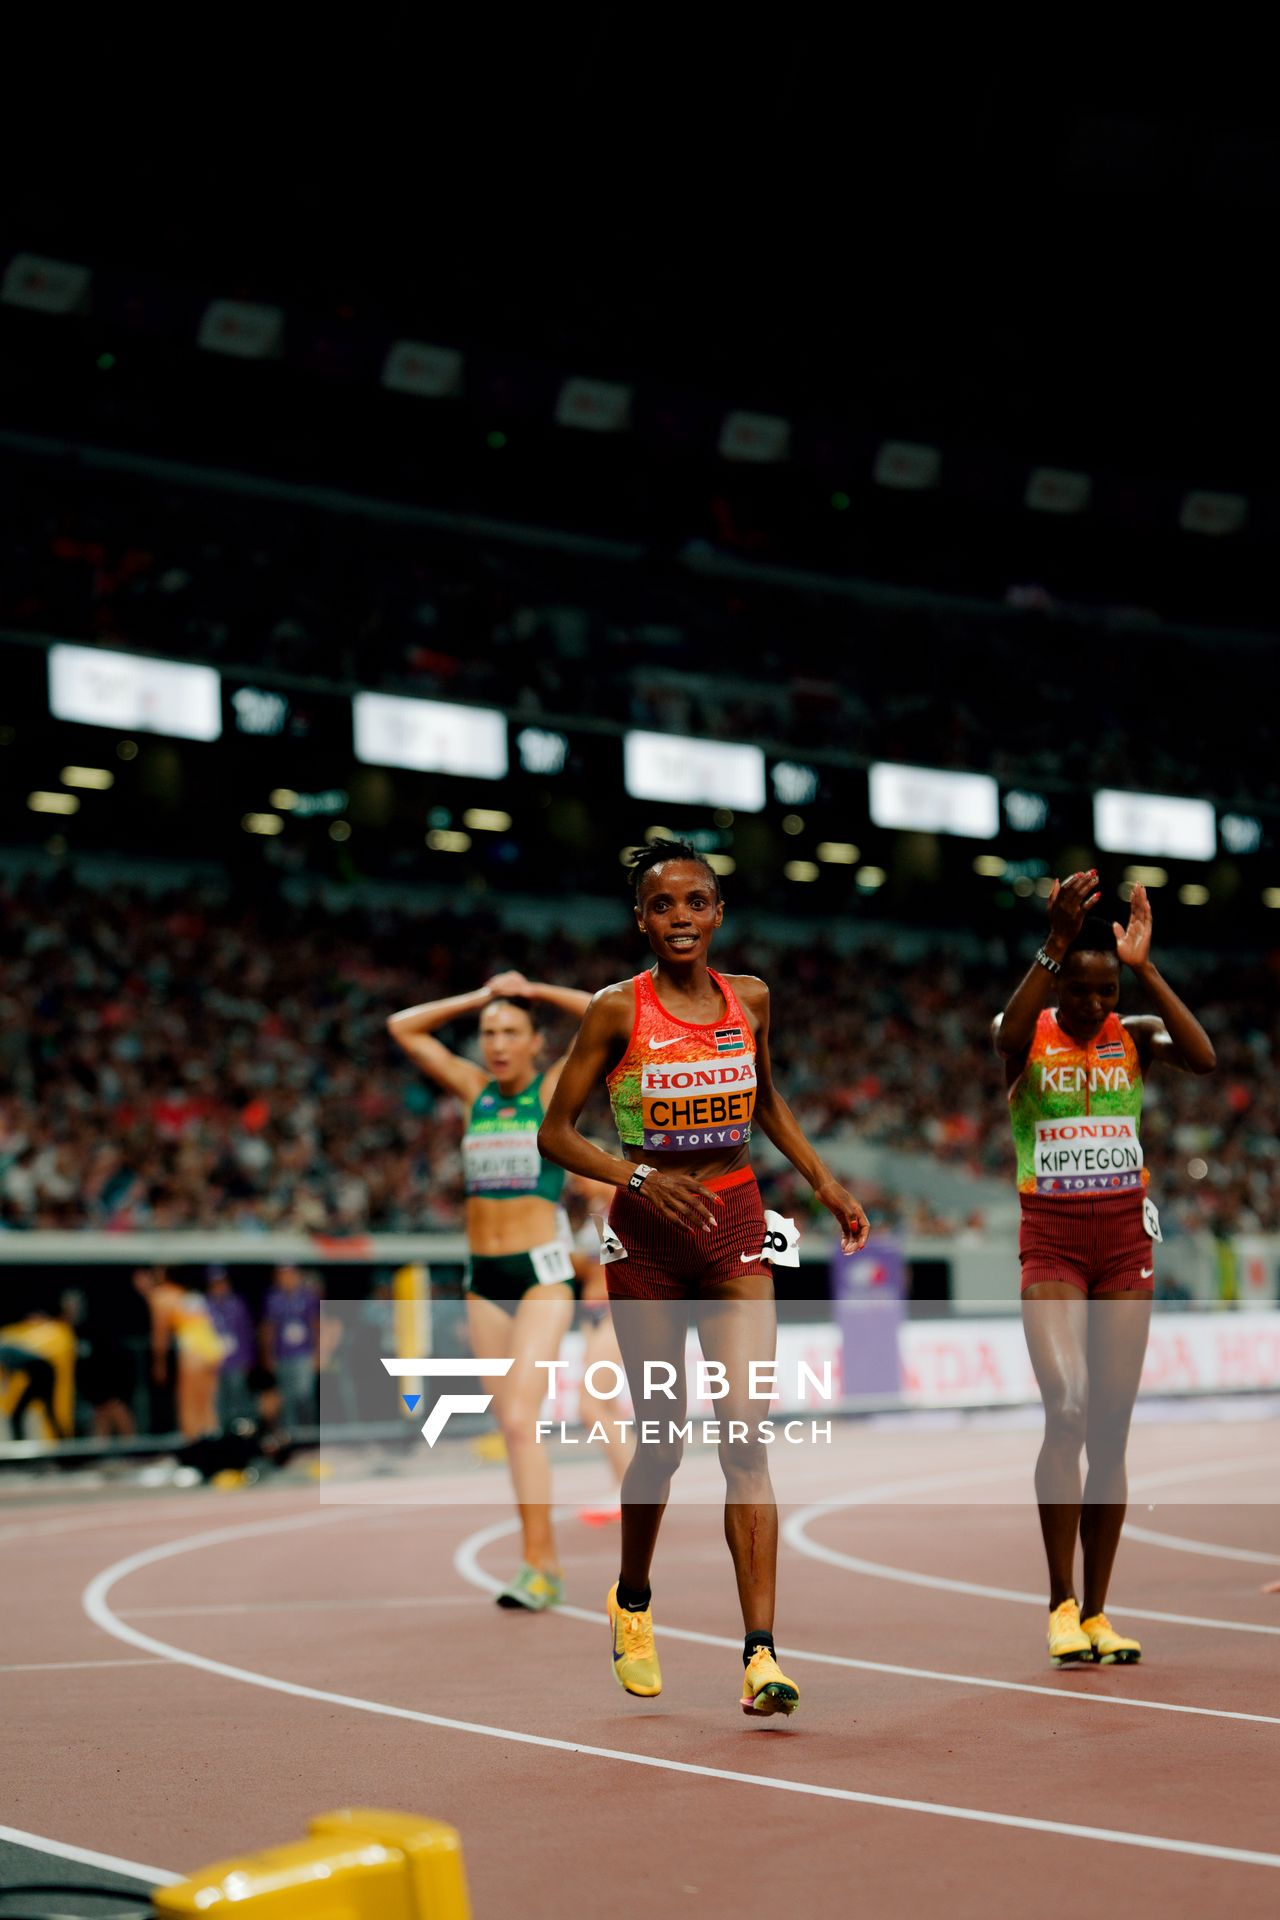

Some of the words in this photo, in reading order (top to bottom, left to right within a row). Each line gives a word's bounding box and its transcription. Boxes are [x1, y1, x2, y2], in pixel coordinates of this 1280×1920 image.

[645, 1064, 755, 1090] HONDA
[1040, 1066, 1131, 1093] KENYA
[650, 1091, 753, 1127] CHEBET
[1038, 1124, 1133, 1143] HONDA
[1040, 1146, 1138, 1172] KIPYEGON
